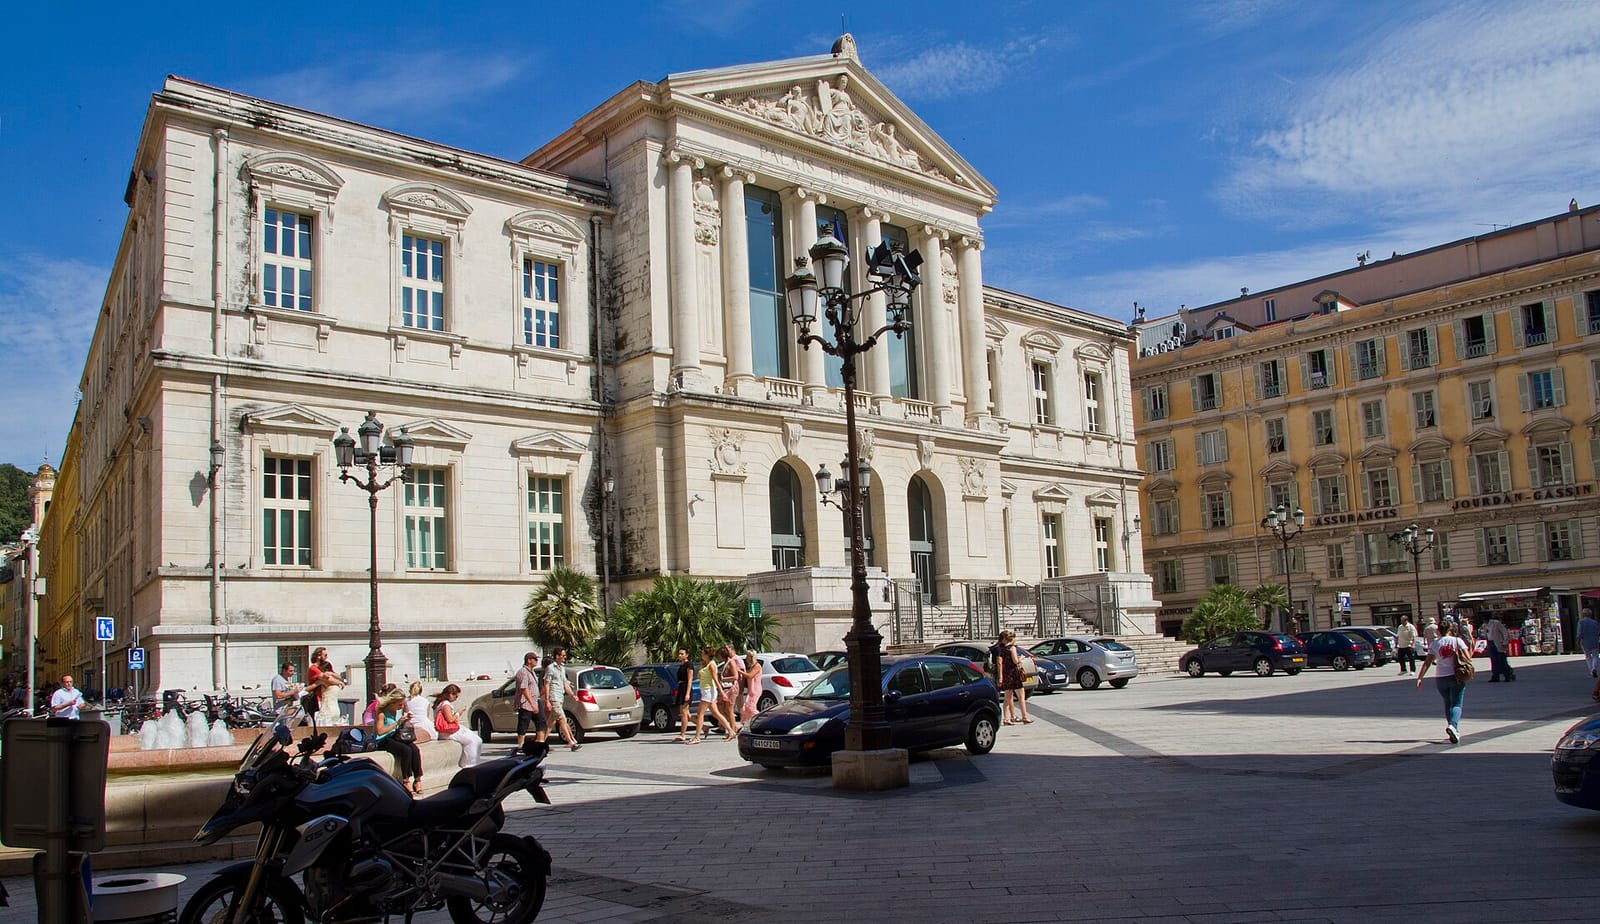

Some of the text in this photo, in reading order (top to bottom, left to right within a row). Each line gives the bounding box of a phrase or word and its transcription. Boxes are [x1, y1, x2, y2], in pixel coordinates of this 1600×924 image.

[758, 144, 920, 206] PALAIS DE JUSTICE
